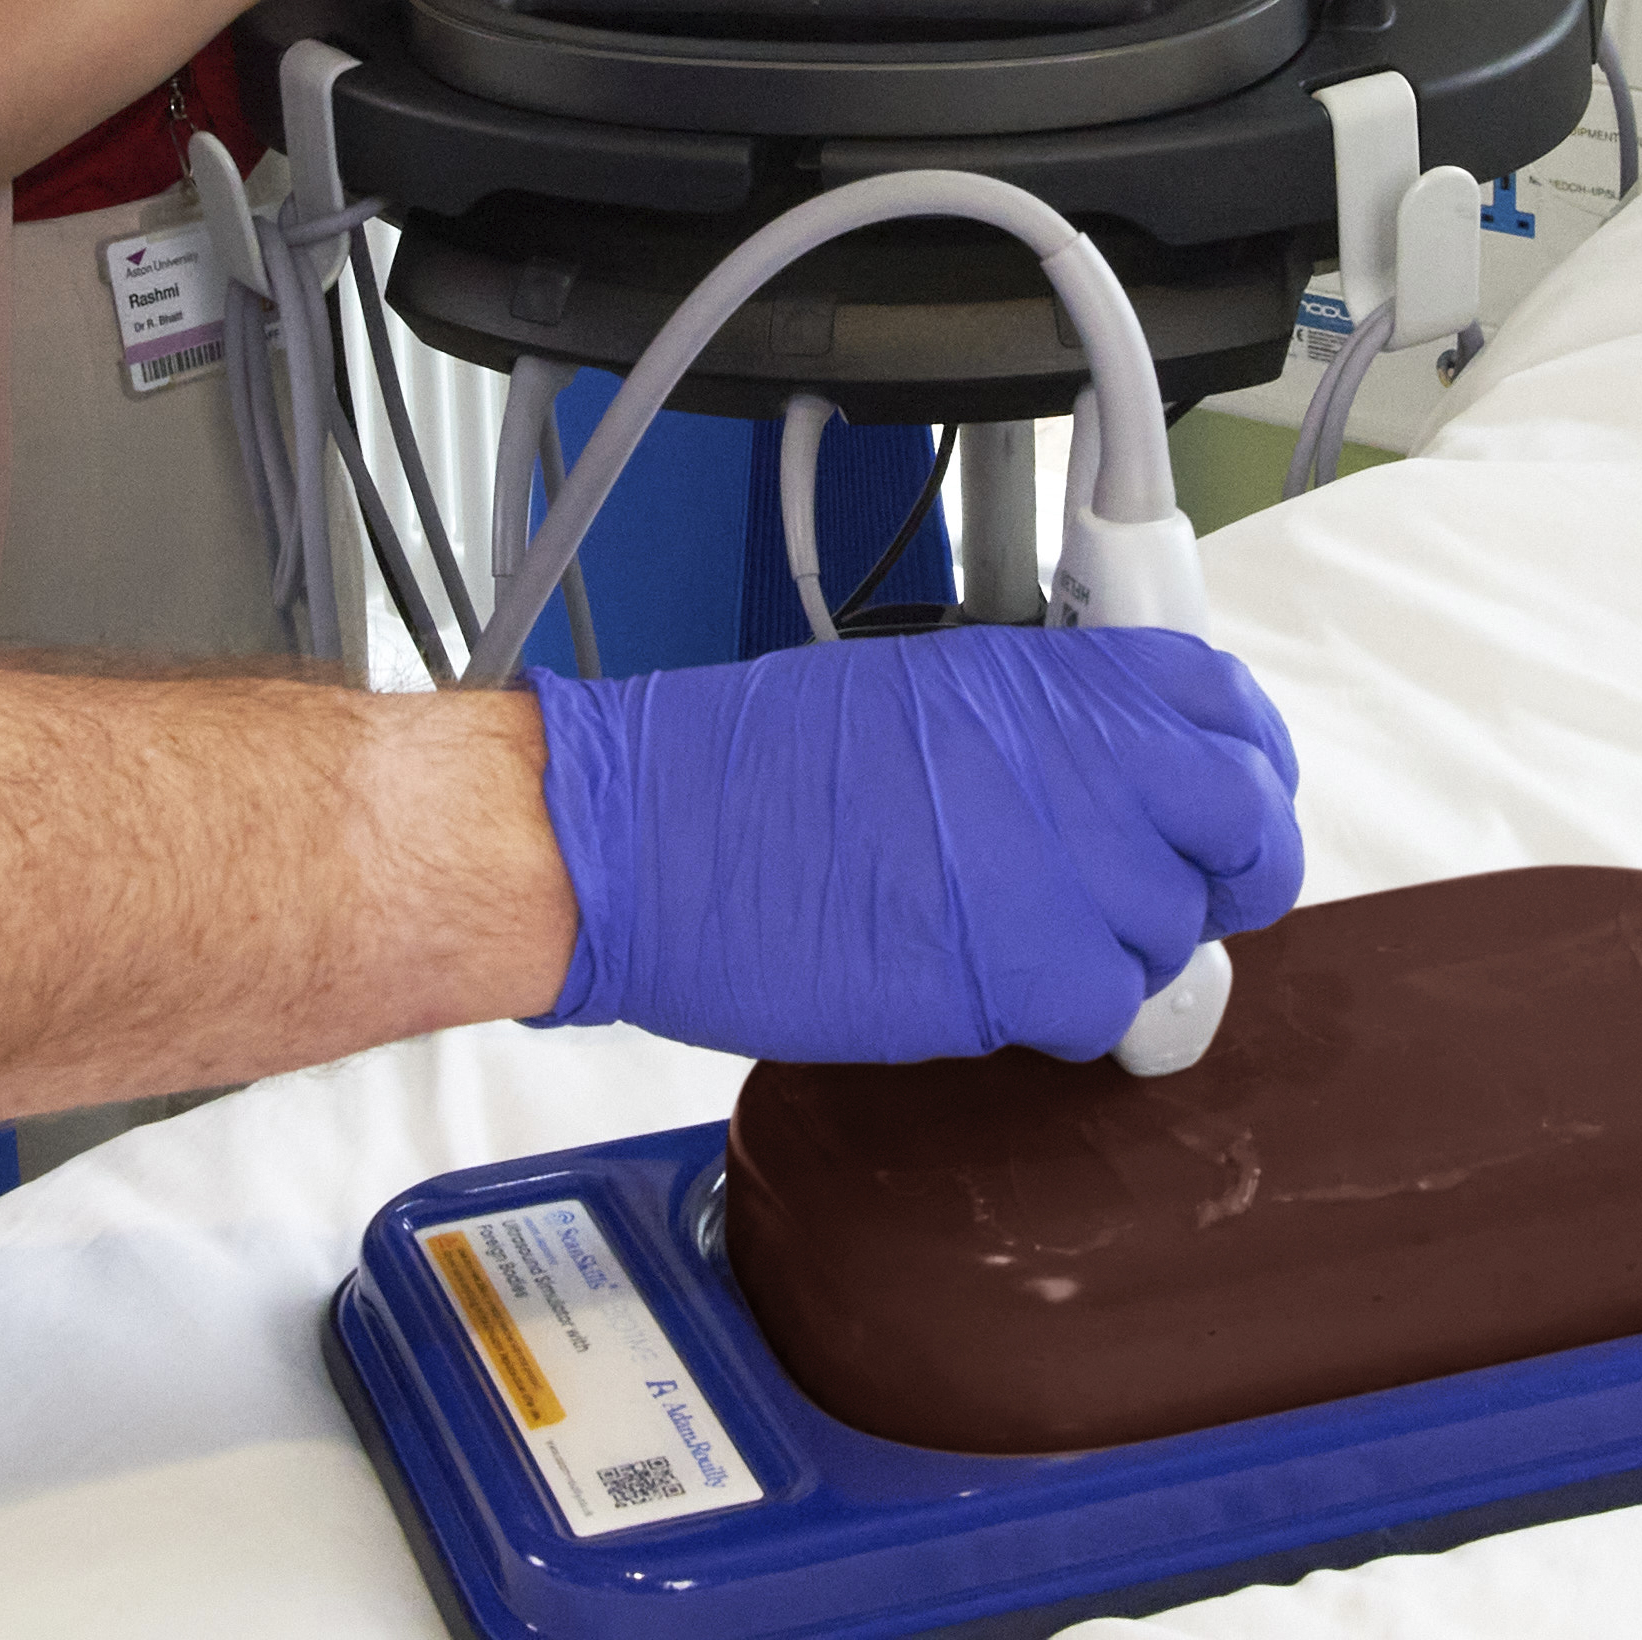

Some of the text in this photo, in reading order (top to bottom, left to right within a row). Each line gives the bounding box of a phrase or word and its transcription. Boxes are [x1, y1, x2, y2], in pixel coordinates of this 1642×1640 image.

[125, 251, 199, 279] Aston University
[128, 282, 181, 310] Rashmi
[133, 321, 145, 333] Dr
[478, 1223, 529, 1298] Foreign Bodies
[502, 1219, 545, 1276] Ultrasound
[533, 1272, 574, 1327] Simulator
[565, 1327, 591, 1353] with
